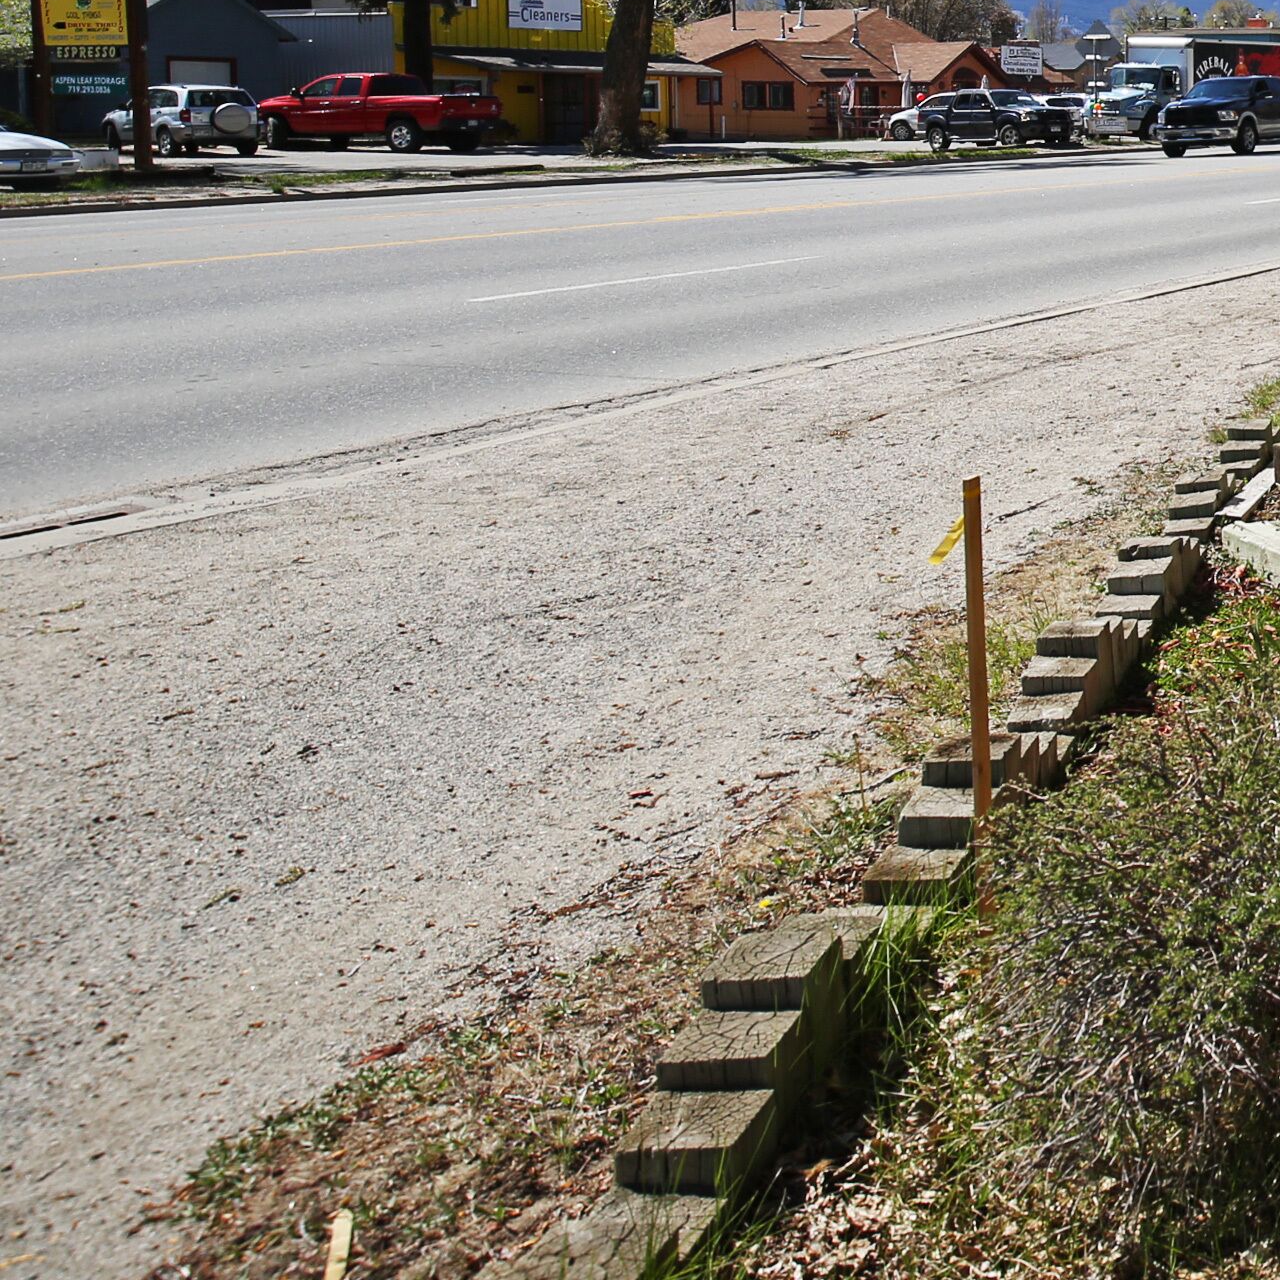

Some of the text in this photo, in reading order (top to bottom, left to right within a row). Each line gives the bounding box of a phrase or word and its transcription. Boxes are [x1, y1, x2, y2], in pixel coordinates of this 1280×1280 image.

[521, 7, 570, 22] Cleaners
[56, 46, 116, 59] ESPRESSO
[1196, 56, 1233, 79] FIREBALL
[55, 77, 126, 85] ASPEN LEAF STORAGE
